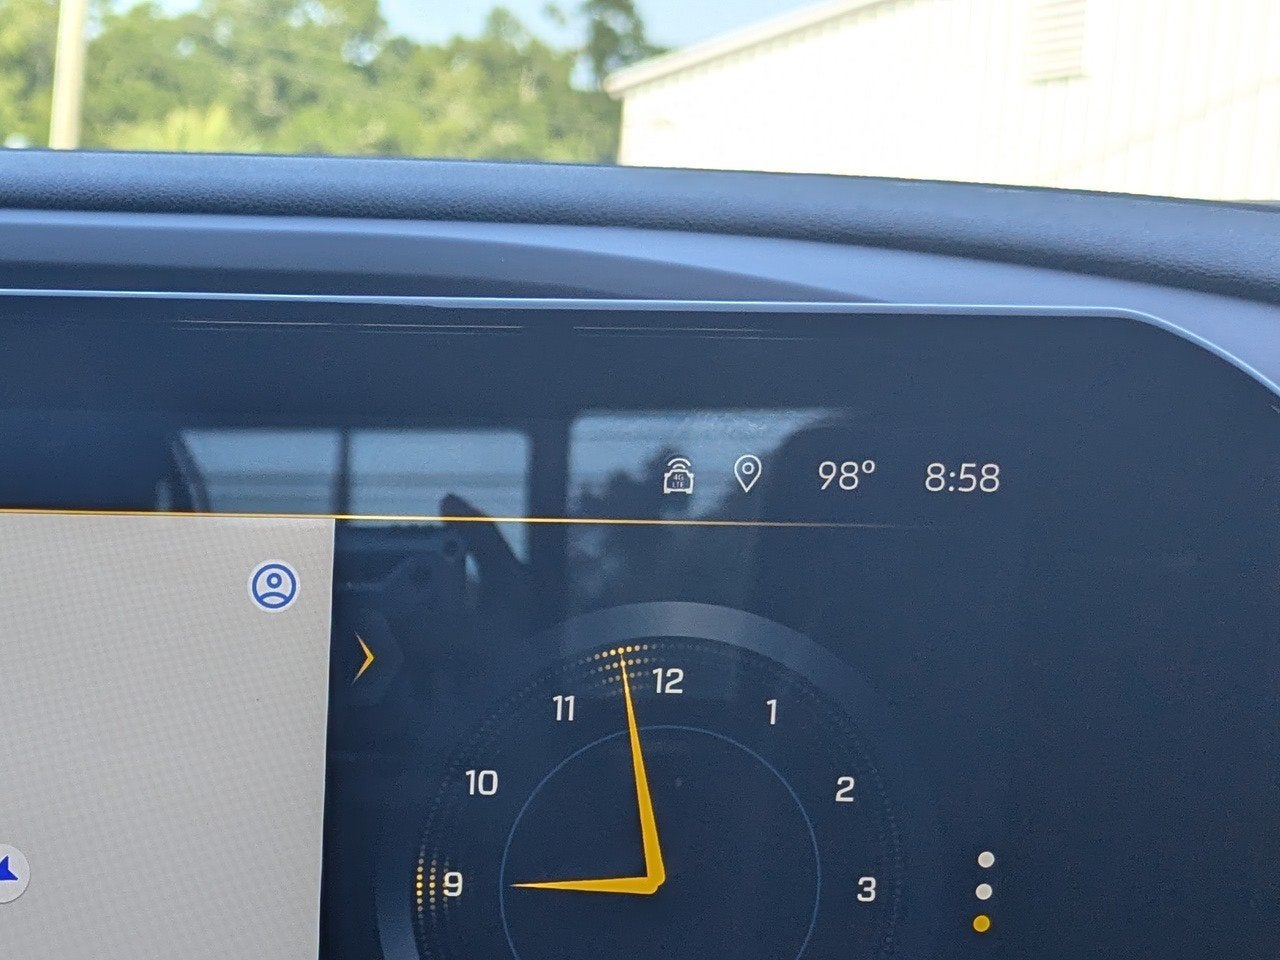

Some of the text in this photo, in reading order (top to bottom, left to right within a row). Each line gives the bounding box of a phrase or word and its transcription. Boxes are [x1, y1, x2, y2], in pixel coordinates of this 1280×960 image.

[925, 462, 1000, 493] 8:58
[652, 667, 684, 694] 12
[552, 695, 575, 722] 11
[766, 698, 777, 725] 1
[465, 769, 499, 796] 10
[835, 776, 855, 803] 2
[443, 872, 463, 897] 9
[856, 876, 877, 902] 3
